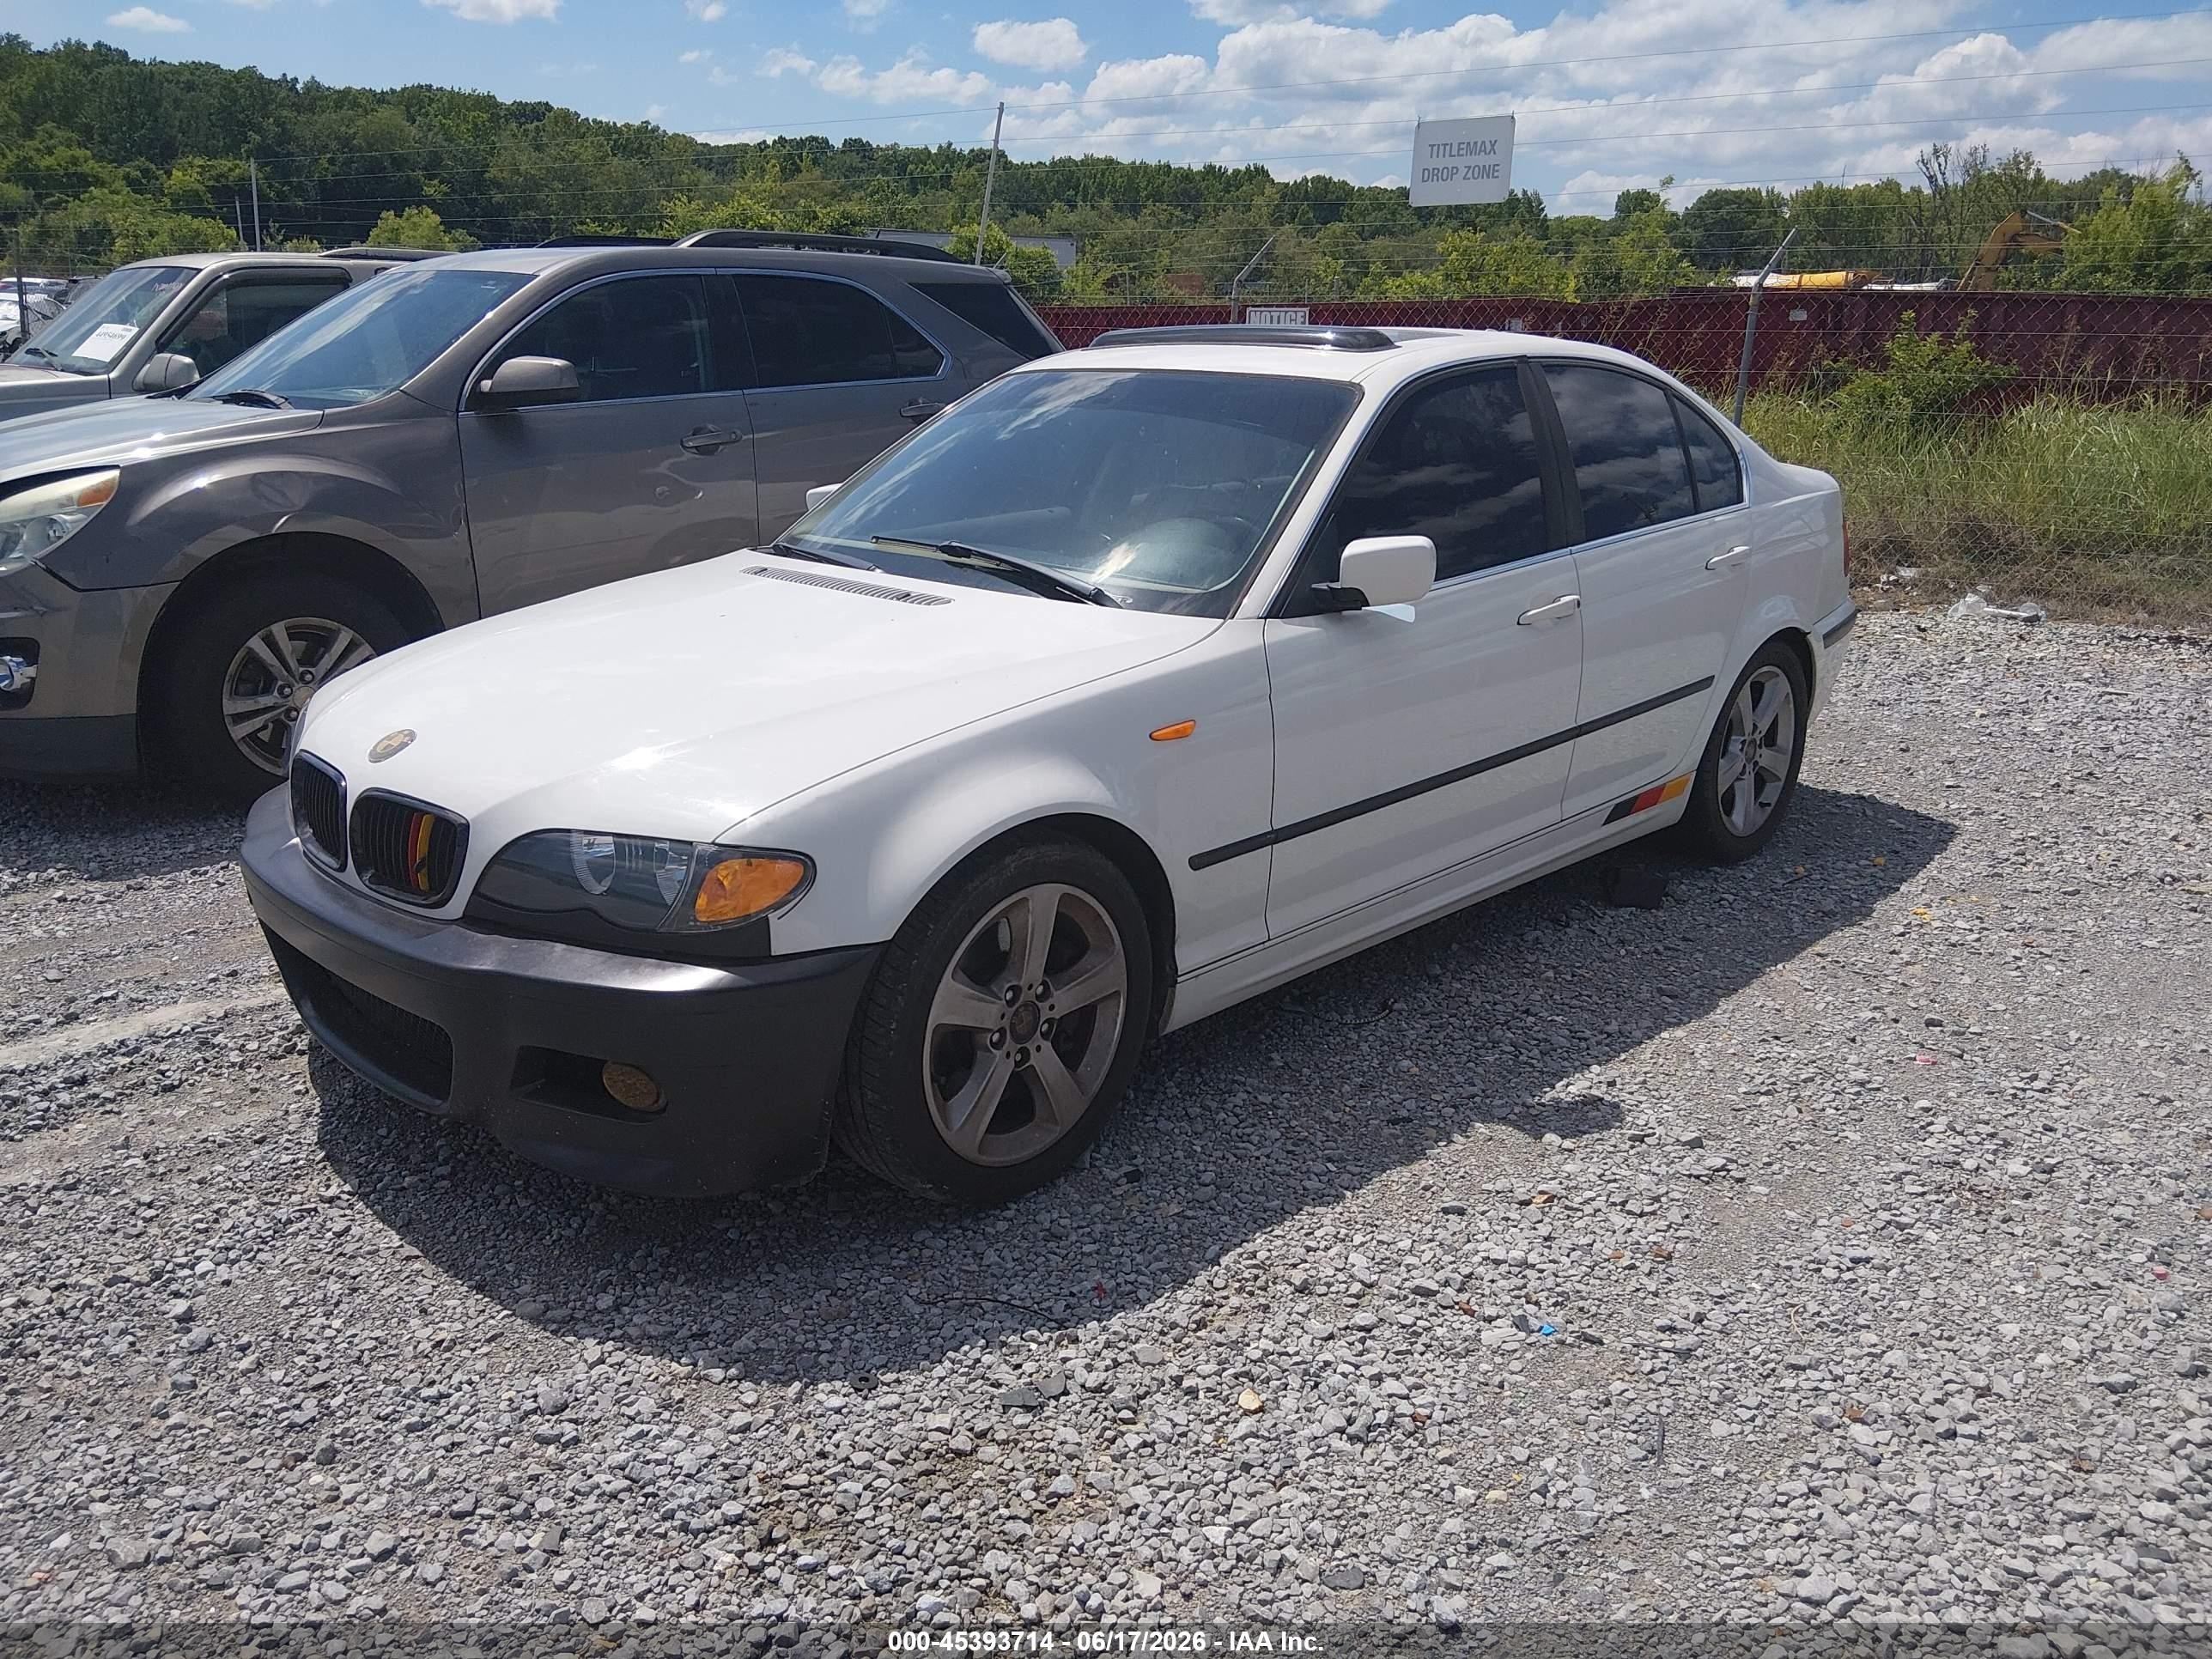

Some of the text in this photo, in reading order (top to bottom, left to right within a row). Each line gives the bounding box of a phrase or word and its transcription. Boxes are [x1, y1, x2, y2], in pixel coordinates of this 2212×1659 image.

[1428, 139, 1498, 158] TITLEMAX
[1421, 163, 1500, 183] DROP ZONE
[1249, 311, 1305, 325] NOTICE
